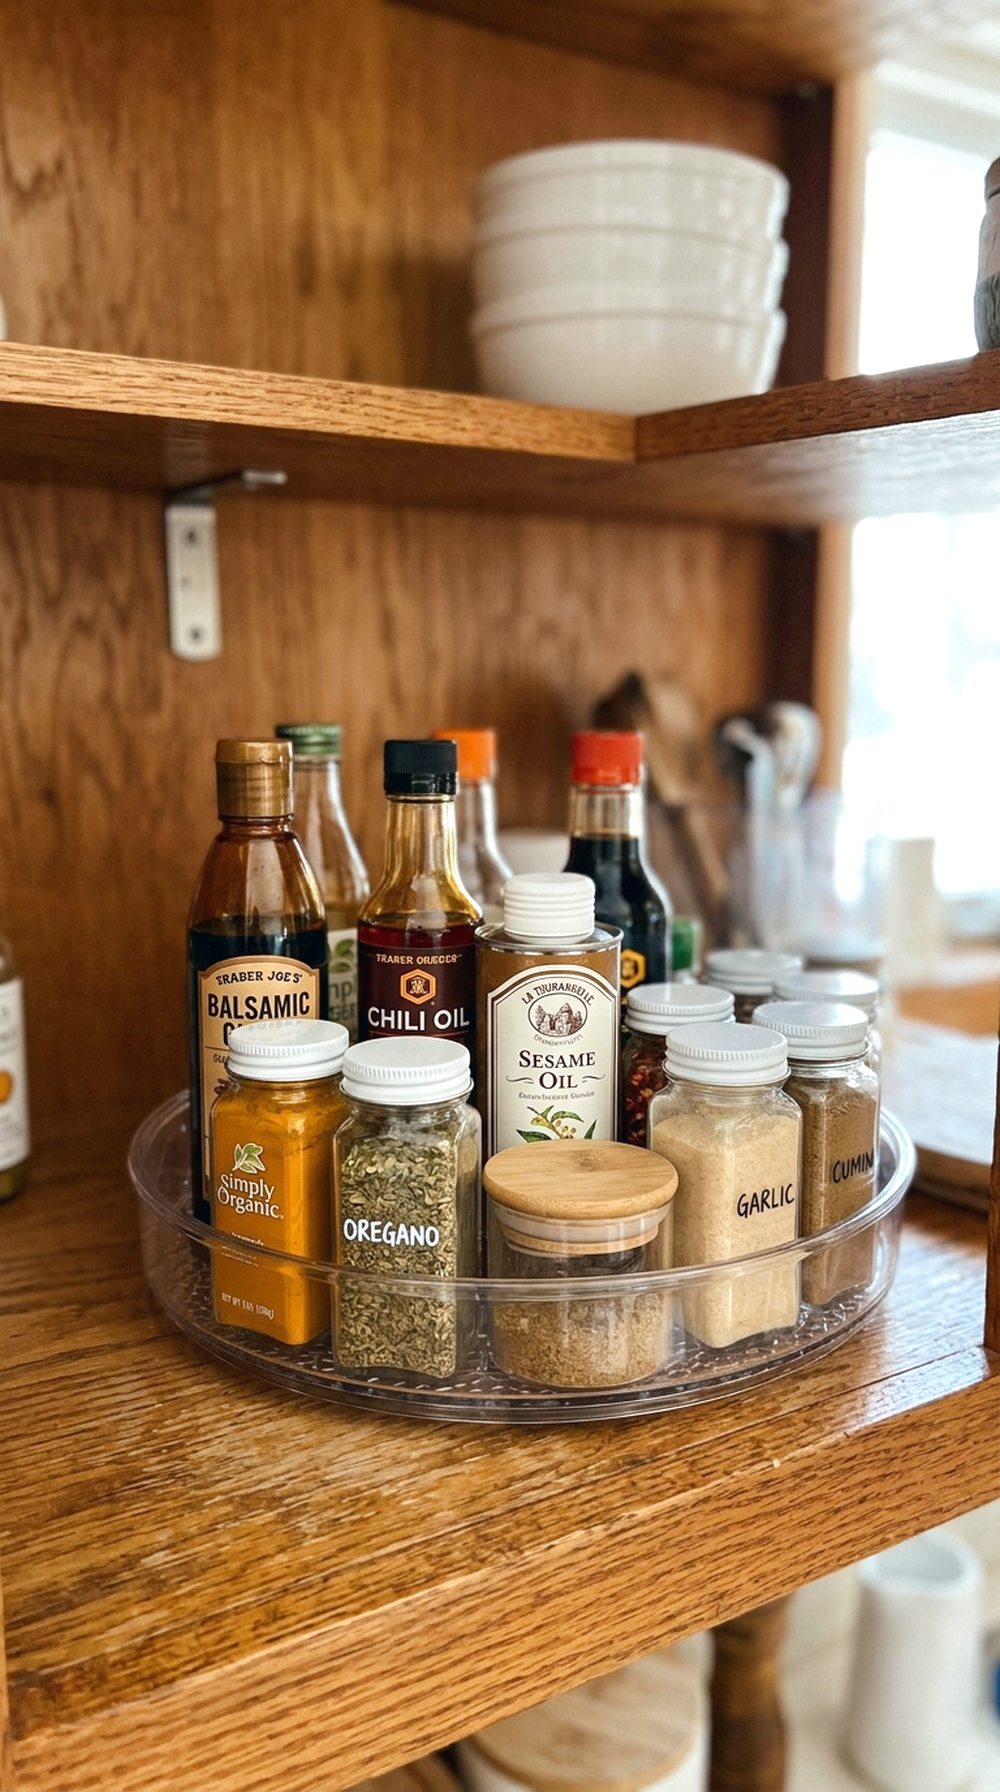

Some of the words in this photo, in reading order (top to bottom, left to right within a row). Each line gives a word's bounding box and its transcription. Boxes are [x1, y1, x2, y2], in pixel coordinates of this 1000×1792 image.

[207, 991, 311, 1020] BALSAMIC
[367, 1006, 425, 1031] CHILI
[433, 1007, 470, 1030] OIL
[518, 1049, 596, 1069] SESAME
[538, 1071, 578, 1090] OIL
[832, 1149, 874, 1184] CUMIN
[220, 1173, 276, 1200] Simply
[736, 1183, 795, 1219] GARLIC
[217, 1185, 281, 1220] Organic
[343, 1218, 440, 1248] OREGANO
